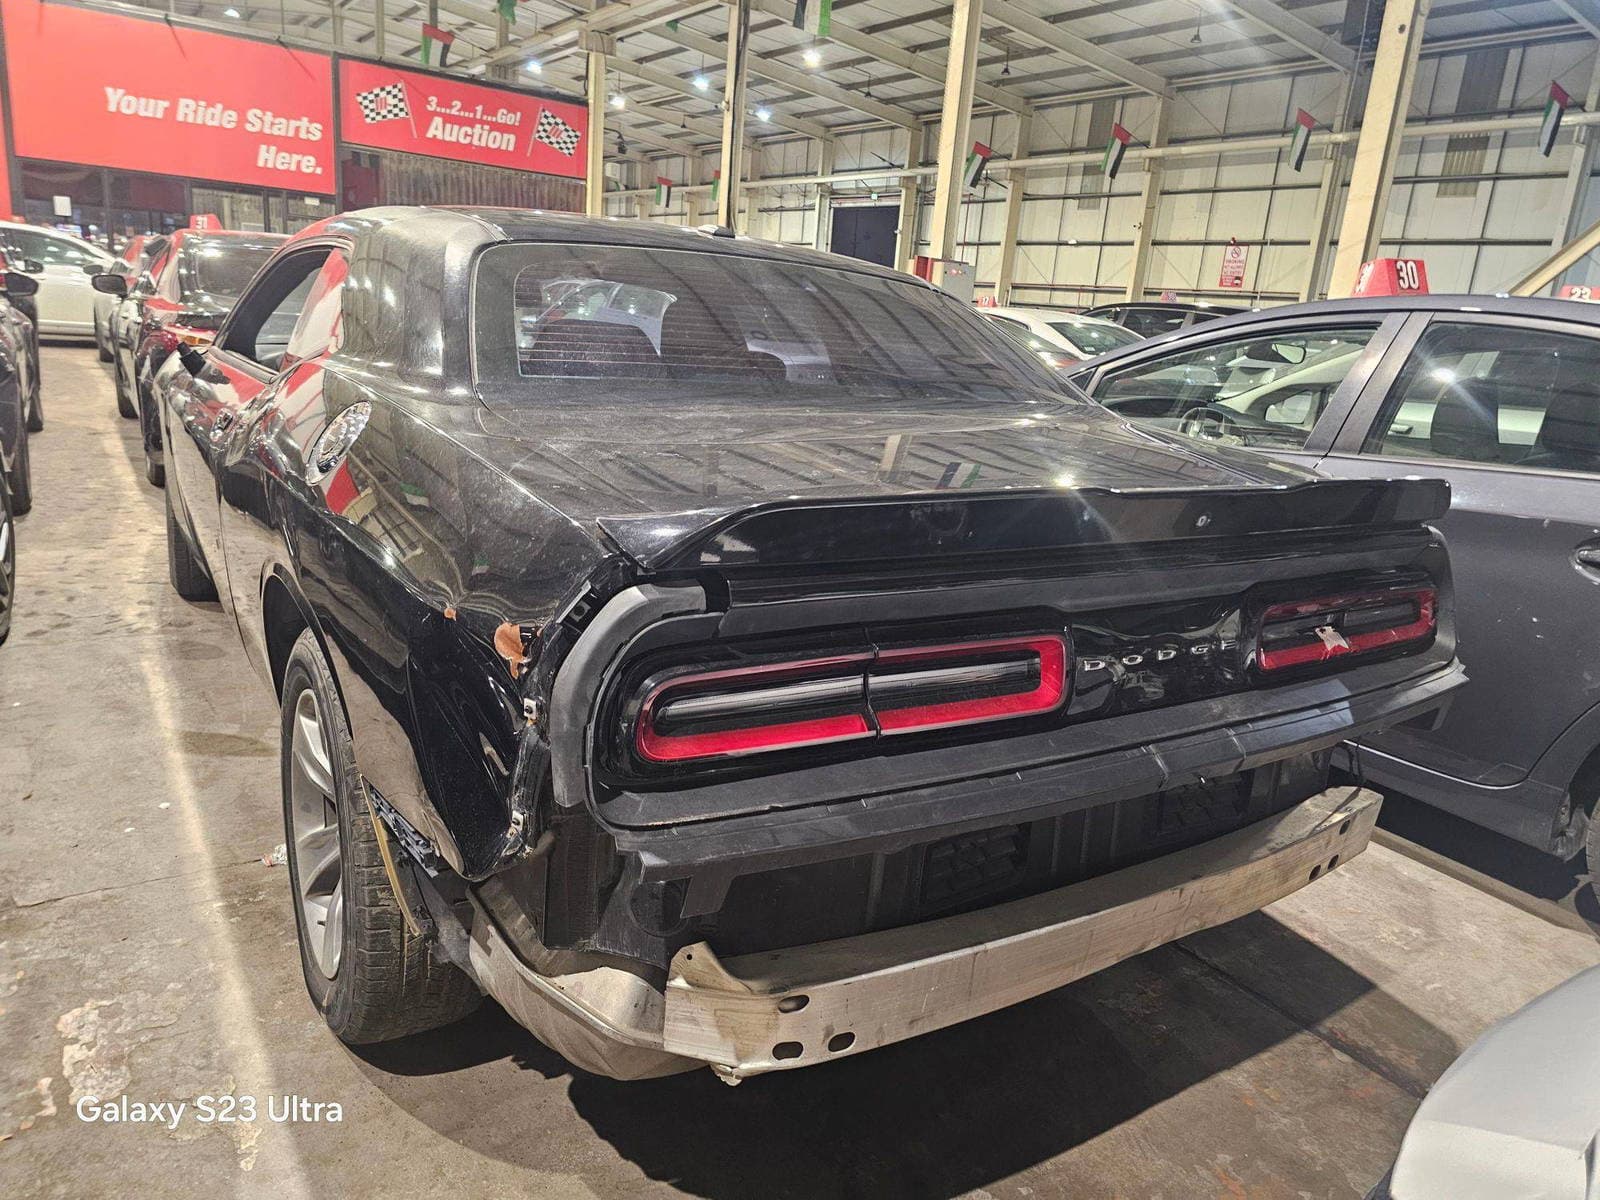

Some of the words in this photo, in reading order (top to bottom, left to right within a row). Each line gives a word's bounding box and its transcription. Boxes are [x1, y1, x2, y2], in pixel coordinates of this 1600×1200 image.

[104, 86, 170, 119] Your
[176, 97, 238, 129] Ride
[244, 108, 323, 141] Starts
[425, 95, 522, 127] 3...2...1...Go!
[425, 116, 517, 152] Auction
[256, 144, 323, 175] Here.
[195, 215, 208, 229] 31
[1396, 260, 1419, 290] 30
[1084, 639, 1237, 671] DODGE
